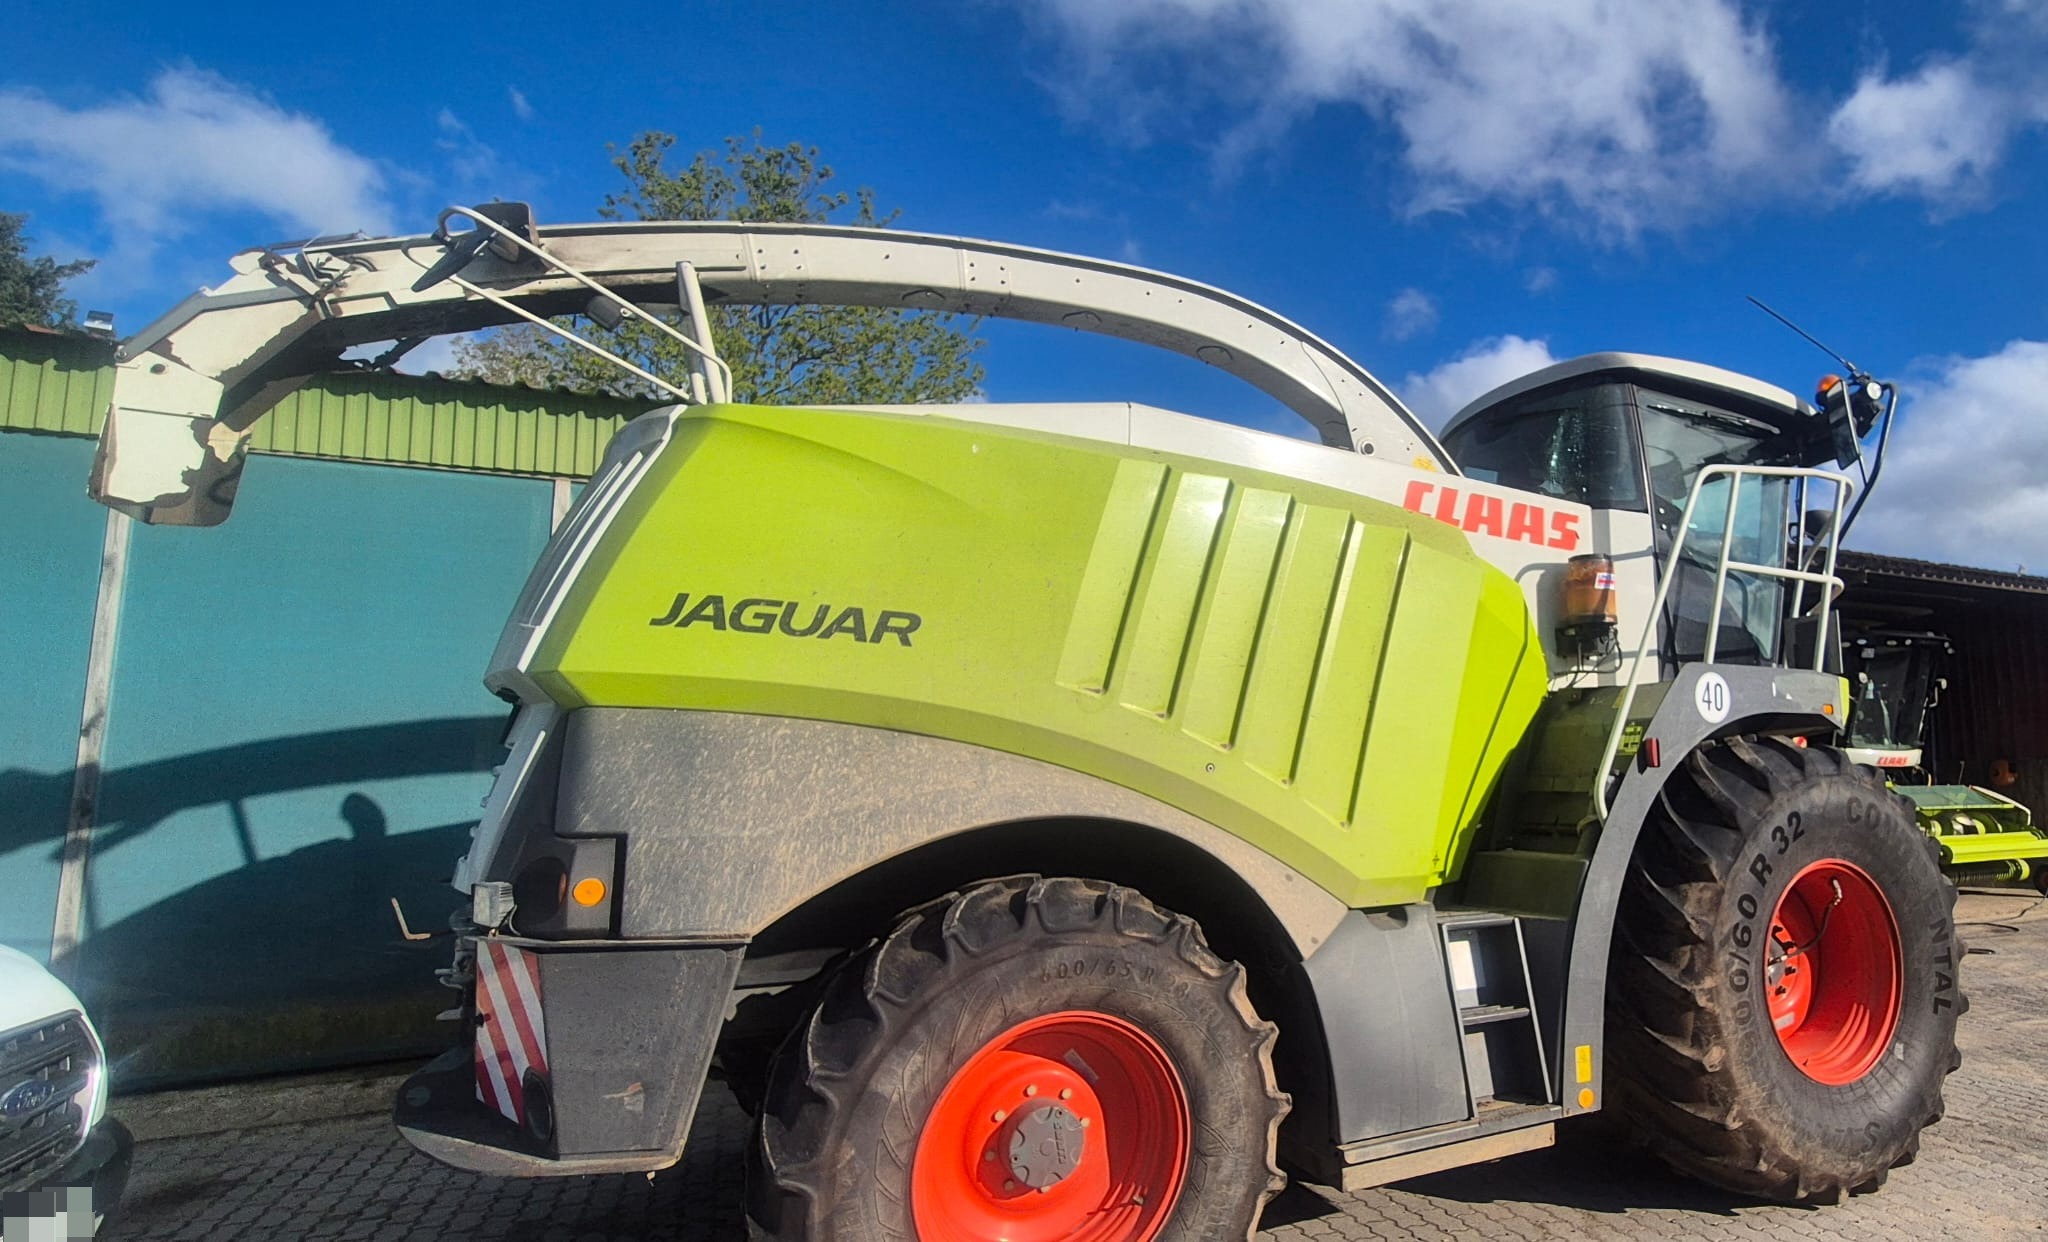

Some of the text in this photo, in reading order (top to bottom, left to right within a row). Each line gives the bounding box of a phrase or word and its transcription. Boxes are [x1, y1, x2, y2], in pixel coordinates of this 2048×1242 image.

[1403, 480, 1579, 550] CLAAS
[649, 592, 921, 647] JAGUAR
[1702, 681, 1723, 711] 40
[1877, 756, 1909, 767] CLAAS
[1749, 853, 1773, 888] R
[1771, 811, 1804, 855] 32
